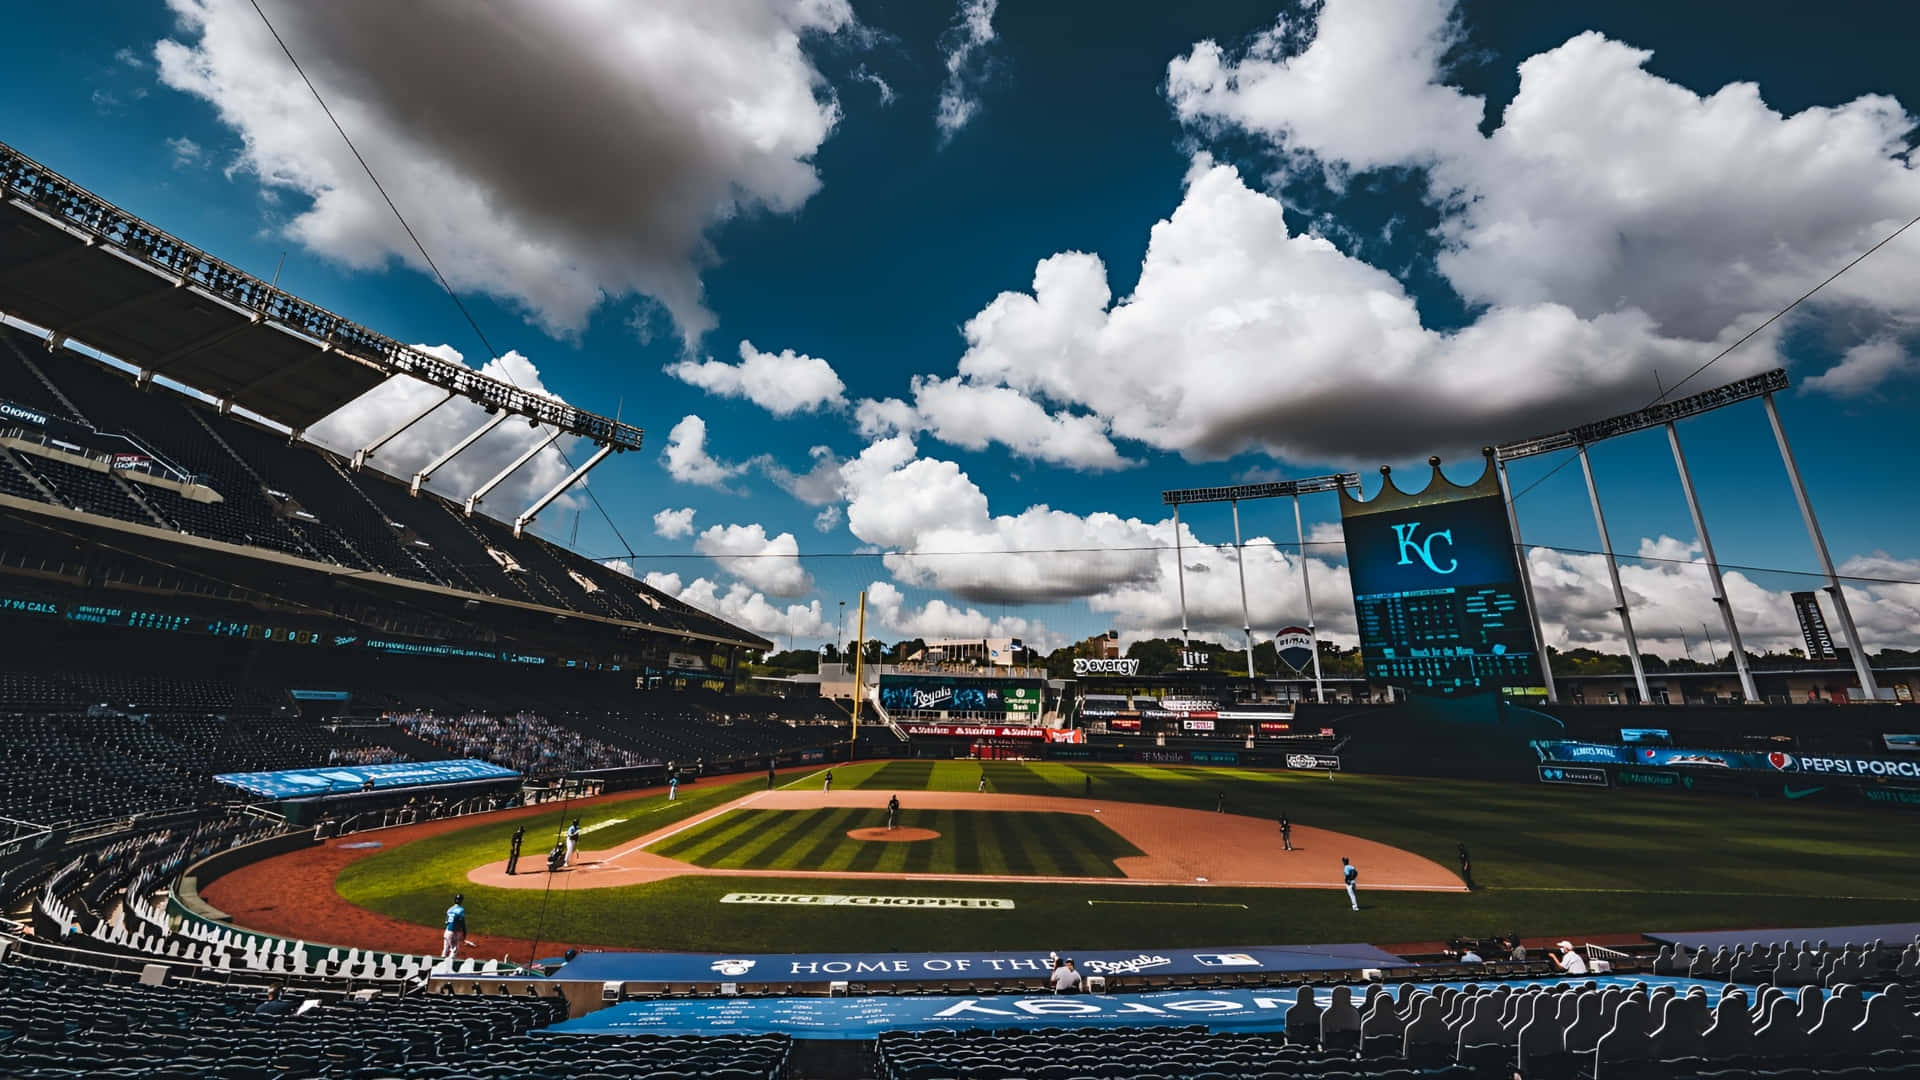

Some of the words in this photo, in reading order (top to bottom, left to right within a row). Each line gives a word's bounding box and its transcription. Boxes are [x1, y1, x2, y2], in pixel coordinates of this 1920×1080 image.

[0, 404, 47, 425] CHOPPER
[1392, 522, 1458, 574] KC
[27, 601, 58, 615] CALS.
[1090, 658, 1139, 676] evergy
[1182, 650, 1209, 668] Lite
[913, 686, 953, 708] Royals
[1802, 756, 1852, 773] PEPSI
[1855, 759, 1920, 777] PORCH
[735, 894, 824, 903] PRICE
[848, 896, 1000, 907] CHOPPER
[790, 959, 910, 974] HOME
[923, 959, 969, 971] OF
[985, 958, 1054, 970] THE
[1084, 953, 1170, 973] Royals
